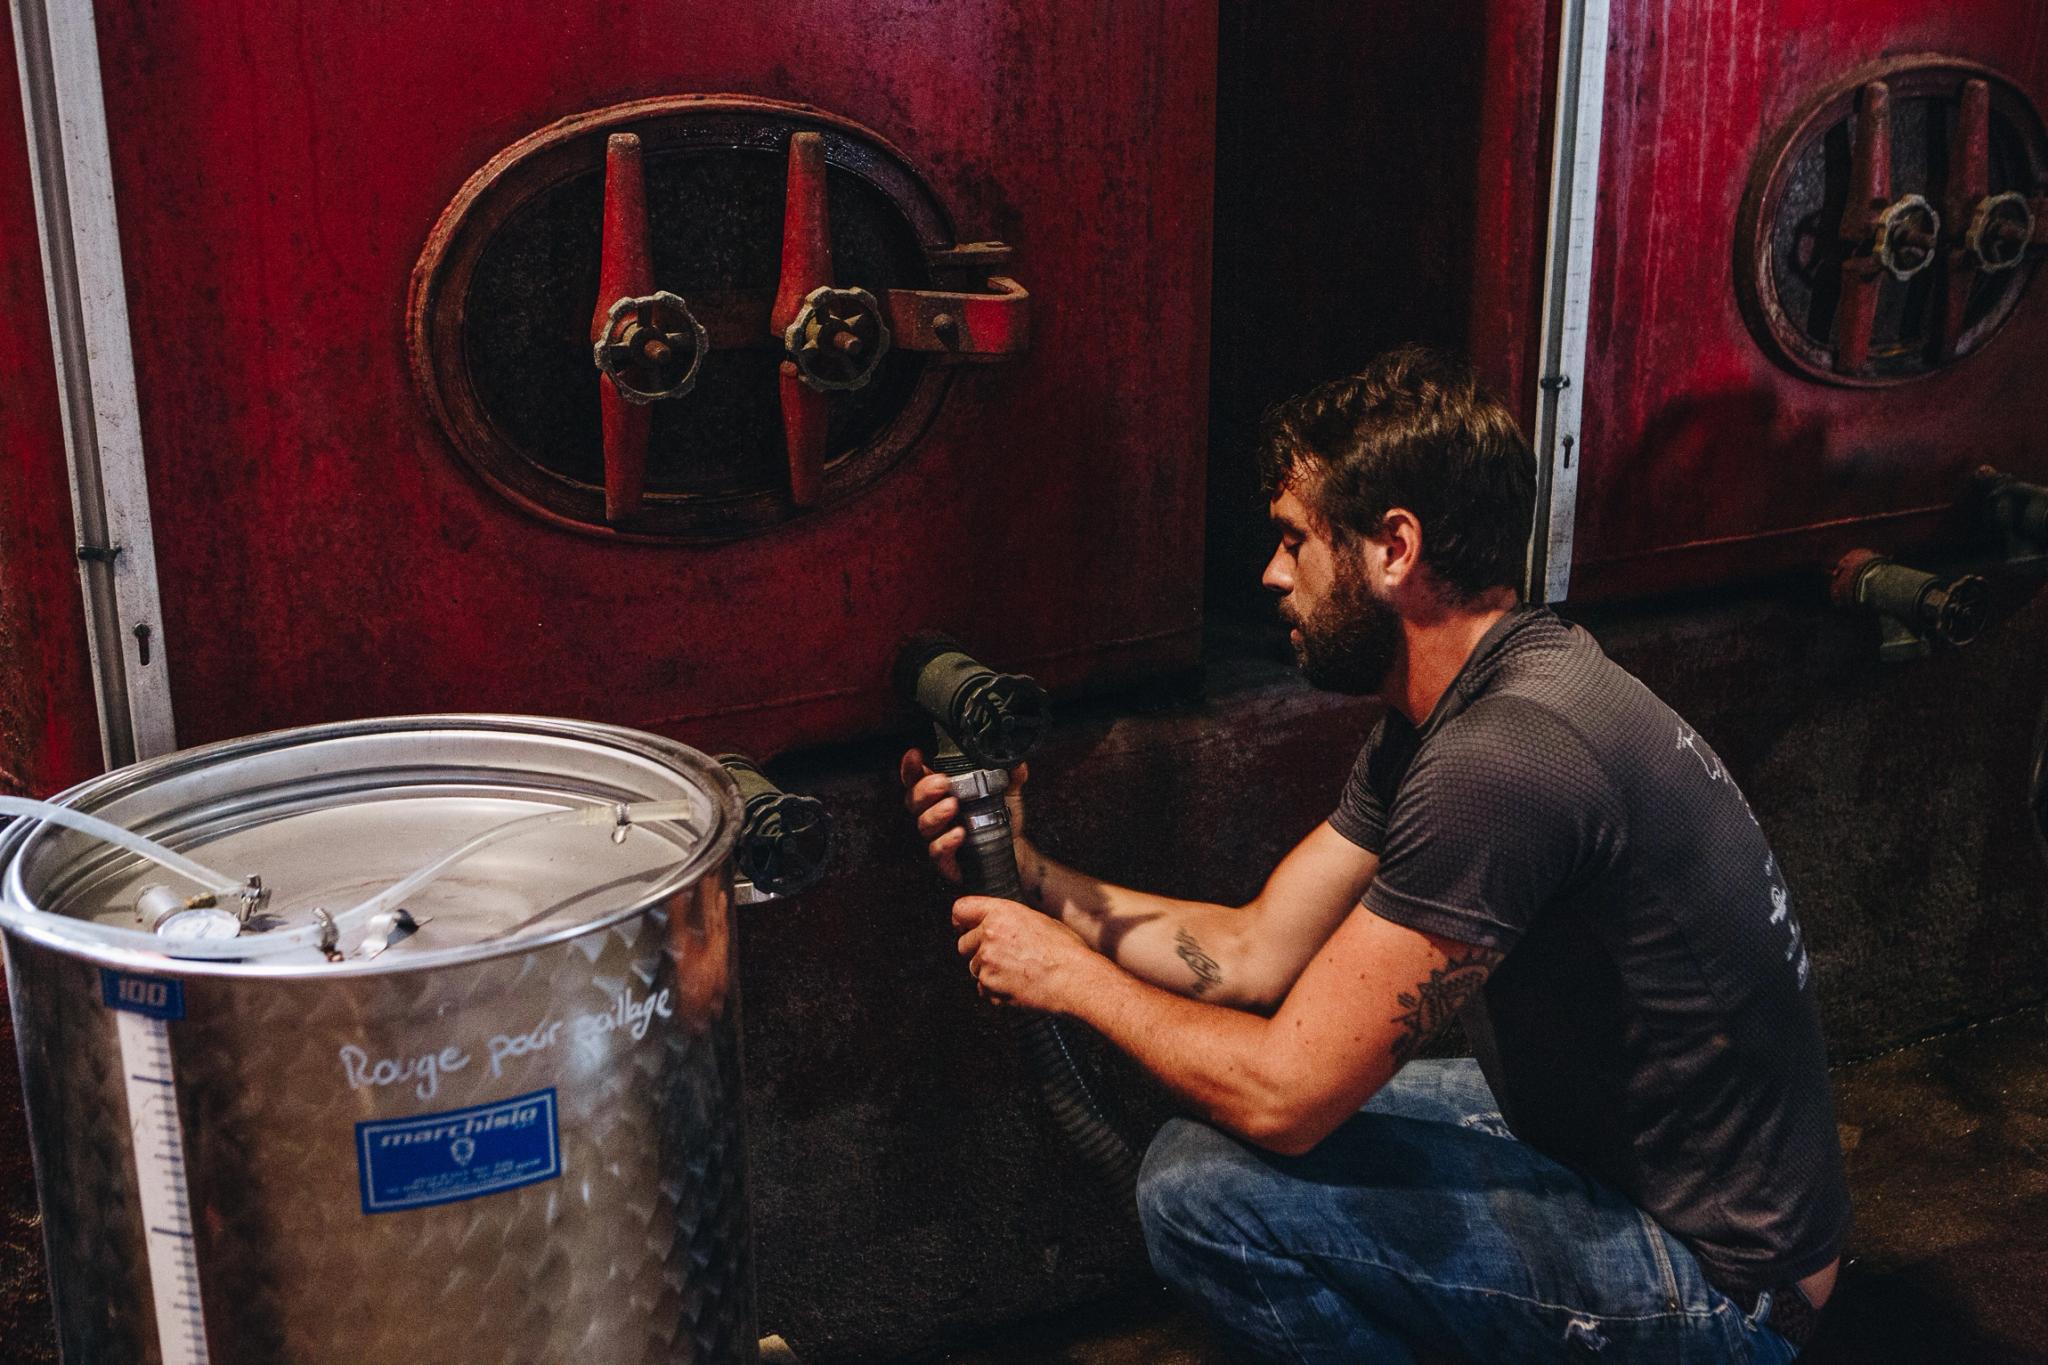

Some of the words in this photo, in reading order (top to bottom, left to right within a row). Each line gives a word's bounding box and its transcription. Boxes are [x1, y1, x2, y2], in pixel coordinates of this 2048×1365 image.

[118, 978, 167, 1007] 100
[340, 1045, 470, 1099] Rouge
[488, 1017, 563, 1078] pour
